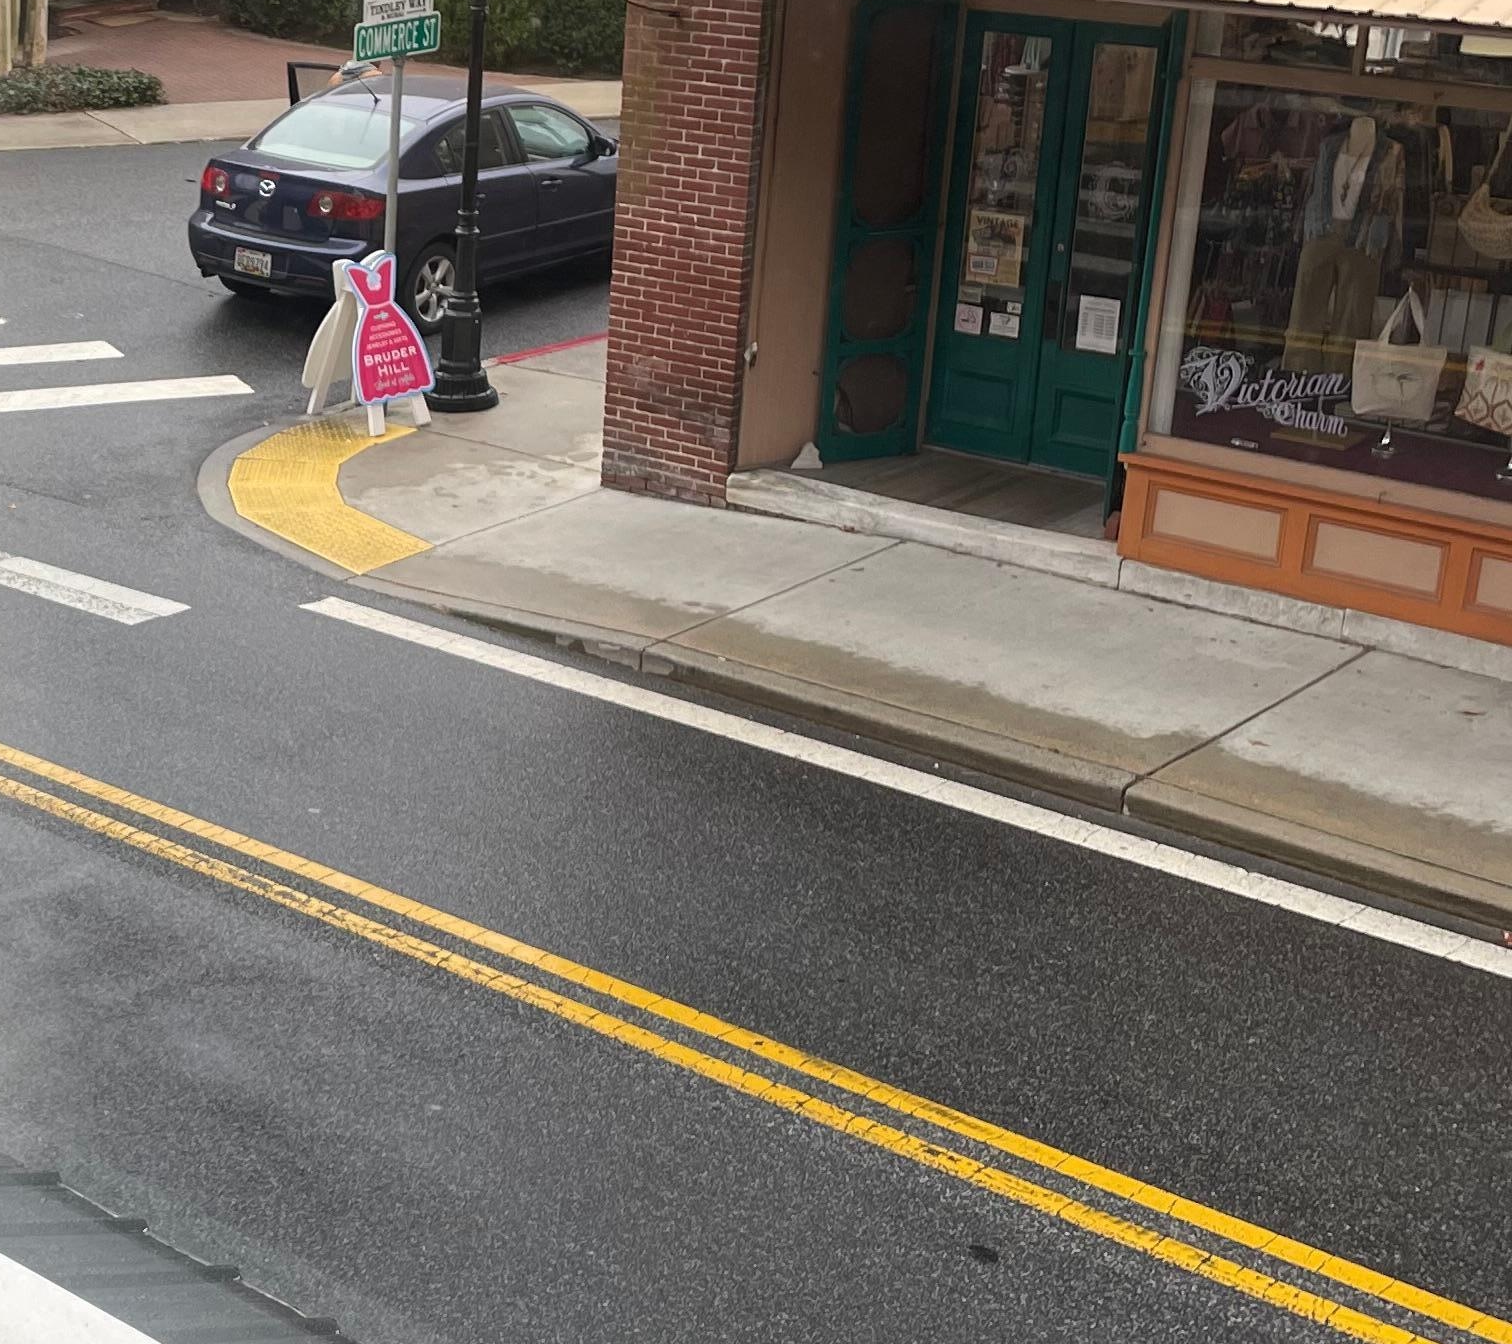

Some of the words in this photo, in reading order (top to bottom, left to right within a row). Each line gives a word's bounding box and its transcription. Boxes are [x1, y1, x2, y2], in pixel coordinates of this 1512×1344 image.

[358, 20, 419, 58] COMMERCE
[422, 17, 437, 47] ST
[976, 215, 1019, 229] VINTAGE
[363, 345, 417, 367] BRUDER
[377, 361, 410, 377] HILL
[1180, 346, 1351, 416] Victorian
[1256, 401, 1348, 437] Charm
